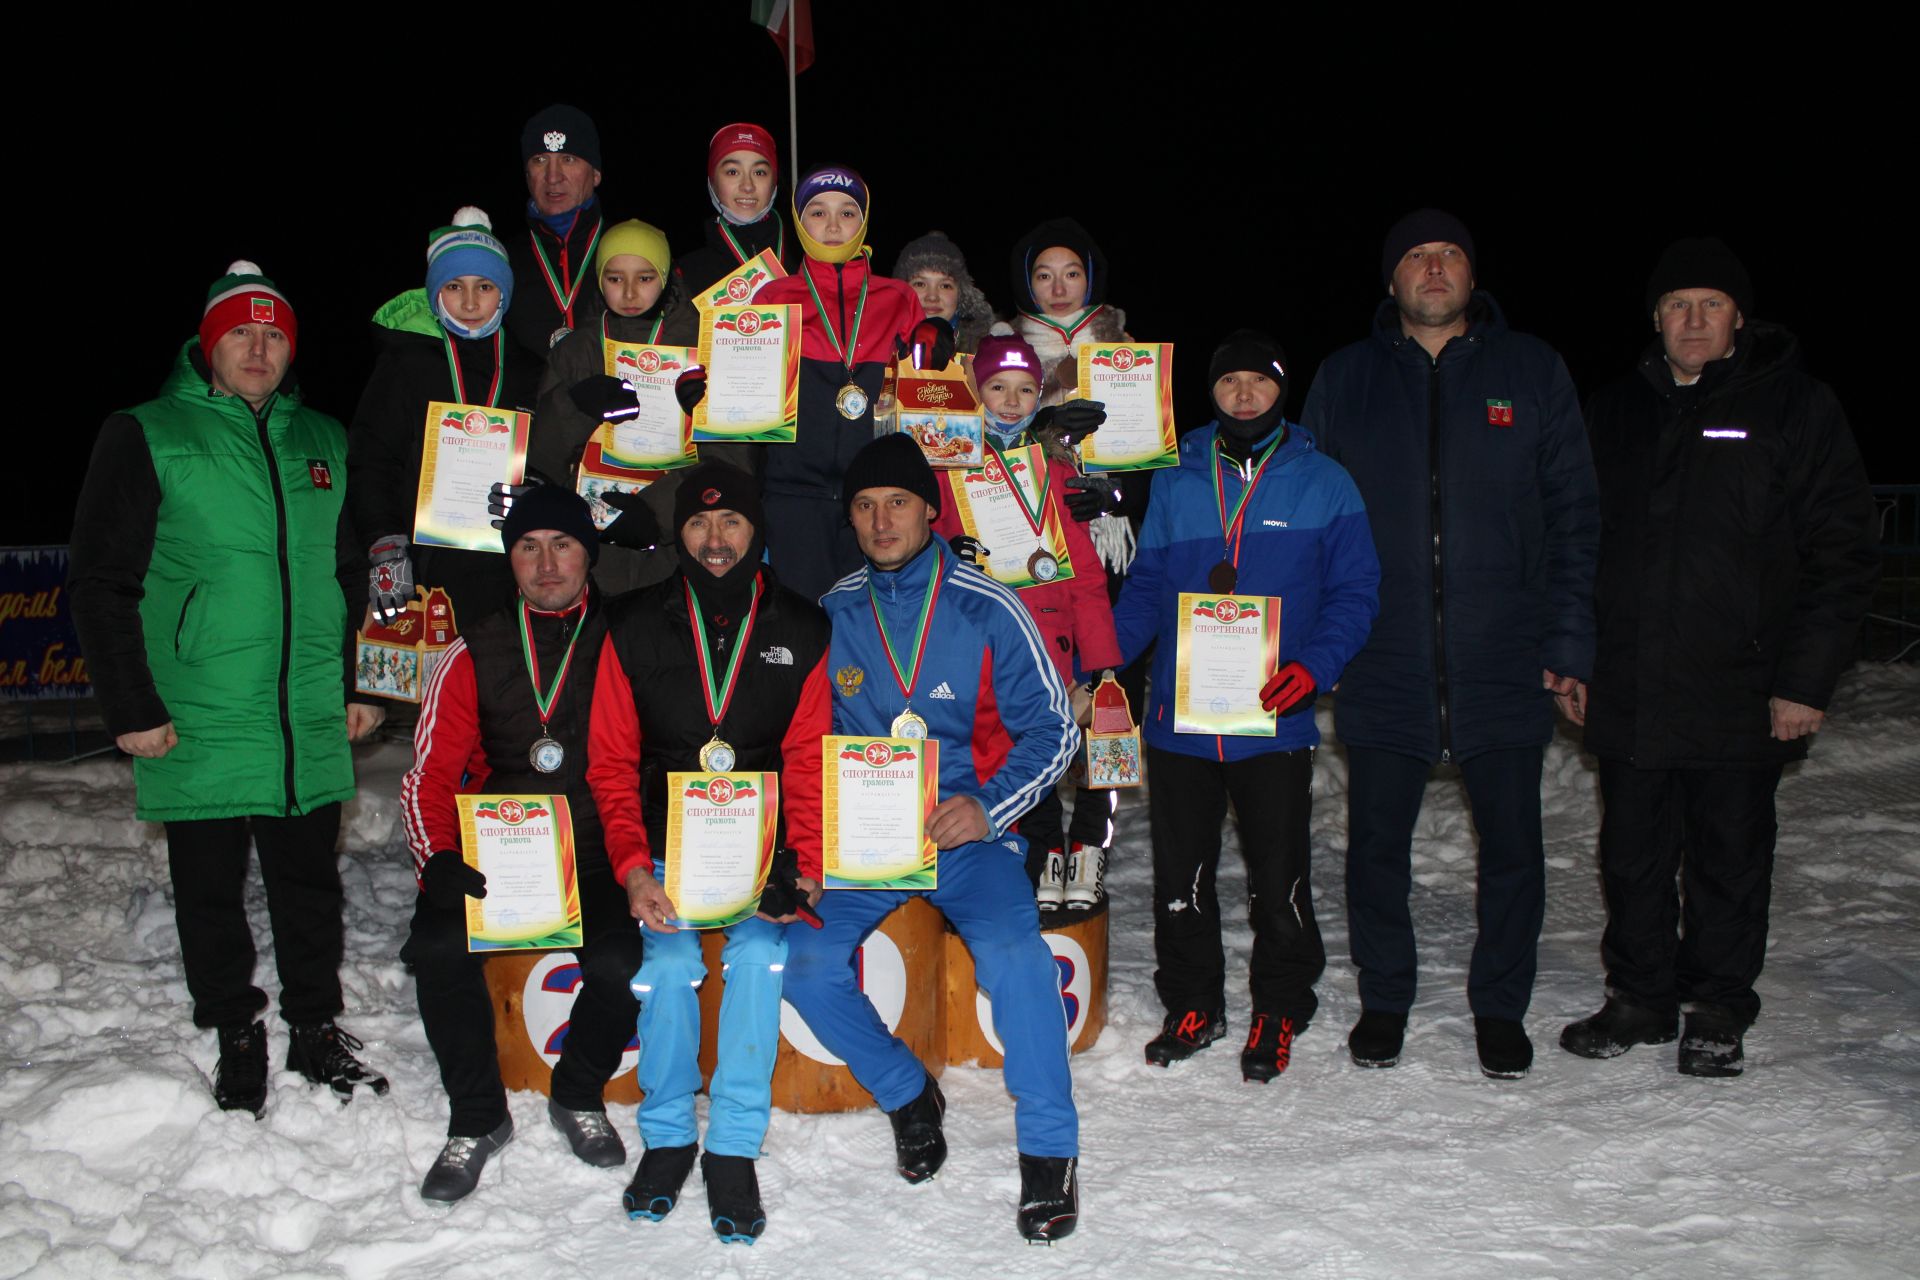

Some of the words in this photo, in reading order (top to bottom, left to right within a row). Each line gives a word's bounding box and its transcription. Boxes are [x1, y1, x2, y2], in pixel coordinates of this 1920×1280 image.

[819, 173, 853, 187] RAY
[715, 337, 780, 346] СПОРТИВНАЯ
[1093, 373, 1153, 382] СПОРТИВНАЯ
[442, 436, 506, 451] СПОРТИВНАЯ
[989, 492, 1014, 503] грамот
[1263, 519, 1288, 528] INOVIX
[385, 618, 416, 636] 025
[1195, 624, 1258, 635] СПОРТИВНАЯ
[929, 692, 956, 700] adidas
[842, 769, 914, 780] СПОРТИВНАЯ
[862, 779, 895, 789] грамота
[686, 807, 755, 817] СПОРТИВНАЯ
[705, 816, 737, 826] грамота
[480, 826, 550, 837] СПОРТИВНАЯ
[500, 836, 532, 846] грамота
